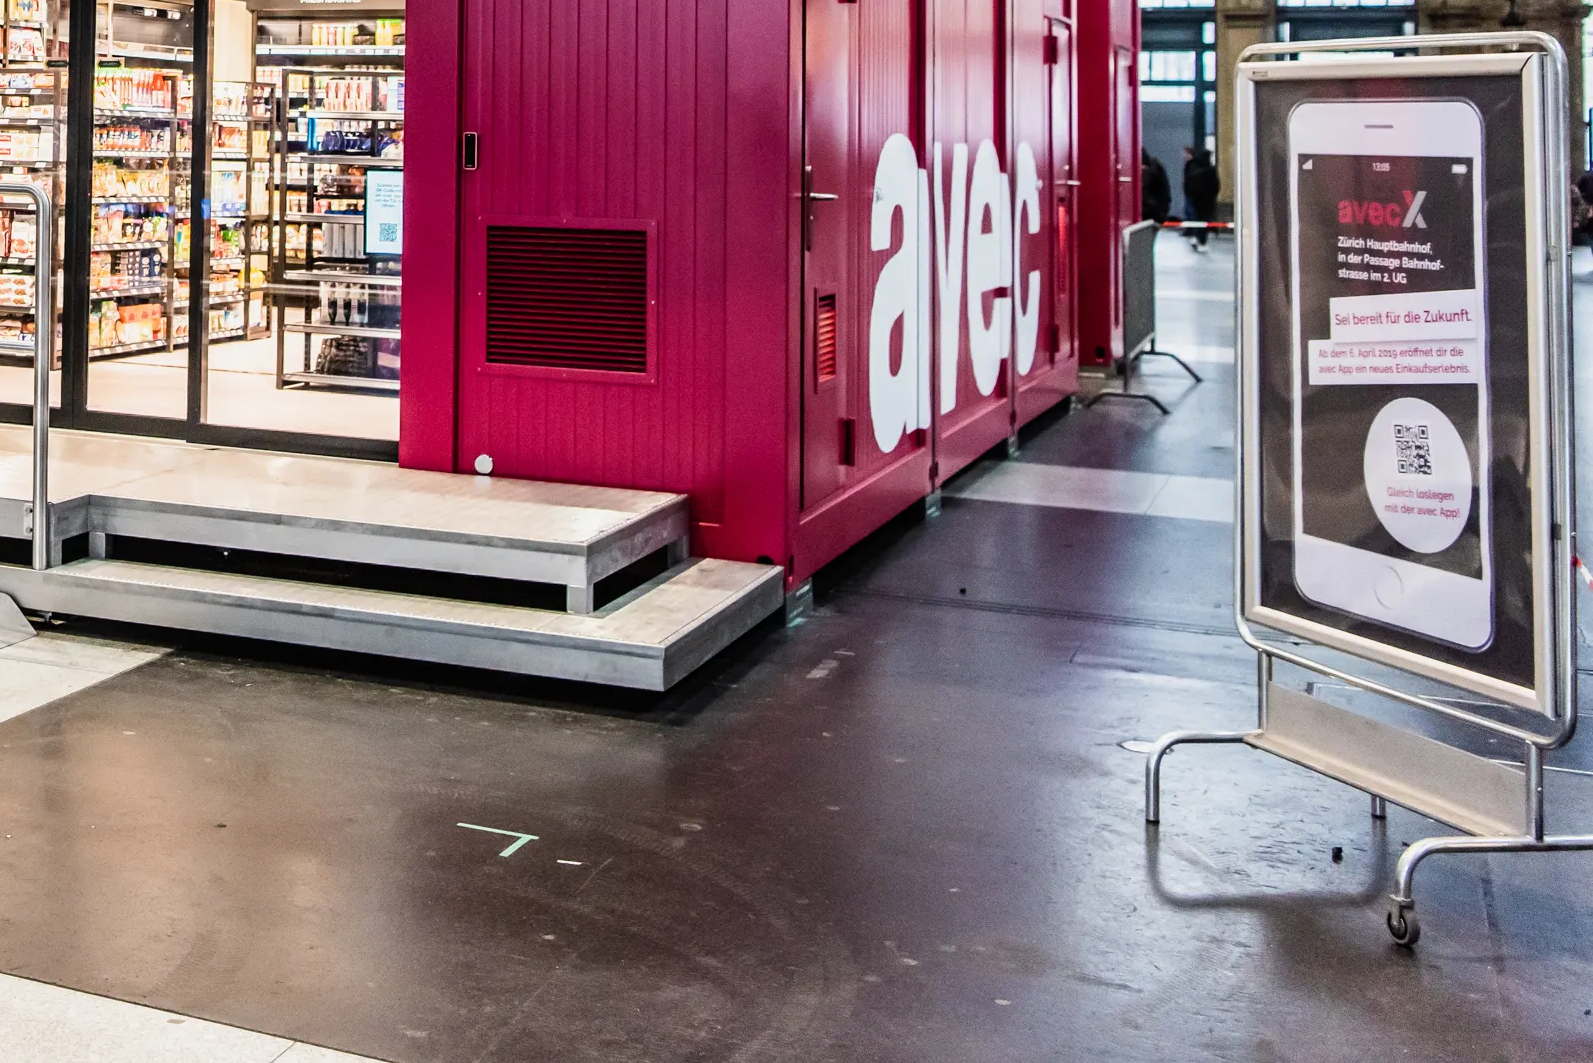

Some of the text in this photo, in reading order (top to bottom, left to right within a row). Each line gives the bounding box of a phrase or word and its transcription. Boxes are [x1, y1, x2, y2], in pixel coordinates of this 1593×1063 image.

[1337, 236, 1433, 254] Zürich Hauptbahnhof,
[1338, 251, 1445, 271] in der Passage Bahnhof-
[1338, 269, 1407, 284] strasse im 2. UG
[868, 132, 1041, 453] avec
[1335, 308, 1473, 326] Sei bereit für die Zukunft.
[1318, 349, 1328, 358] Ab
[1330, 348, 1347, 358] dem
[1358, 348, 1377, 360] April
[1378, 350, 1397, 359] 2019
[1399, 347, 1433, 358] eröffnet
[1449, 347, 1464, 357] die
[1318, 366, 1336, 374] avec
[1338, 364, 1354, 376] App
[1355, 364, 1367, 374] ein
[1369, 365, 1394, 374] neues
[1386, 486, 1455, 503] Gleich loslegen
[1384, 503, 1399, 513] mit
[1400, 504, 1415, 515] der
[1417, 507, 1438, 517] avec
